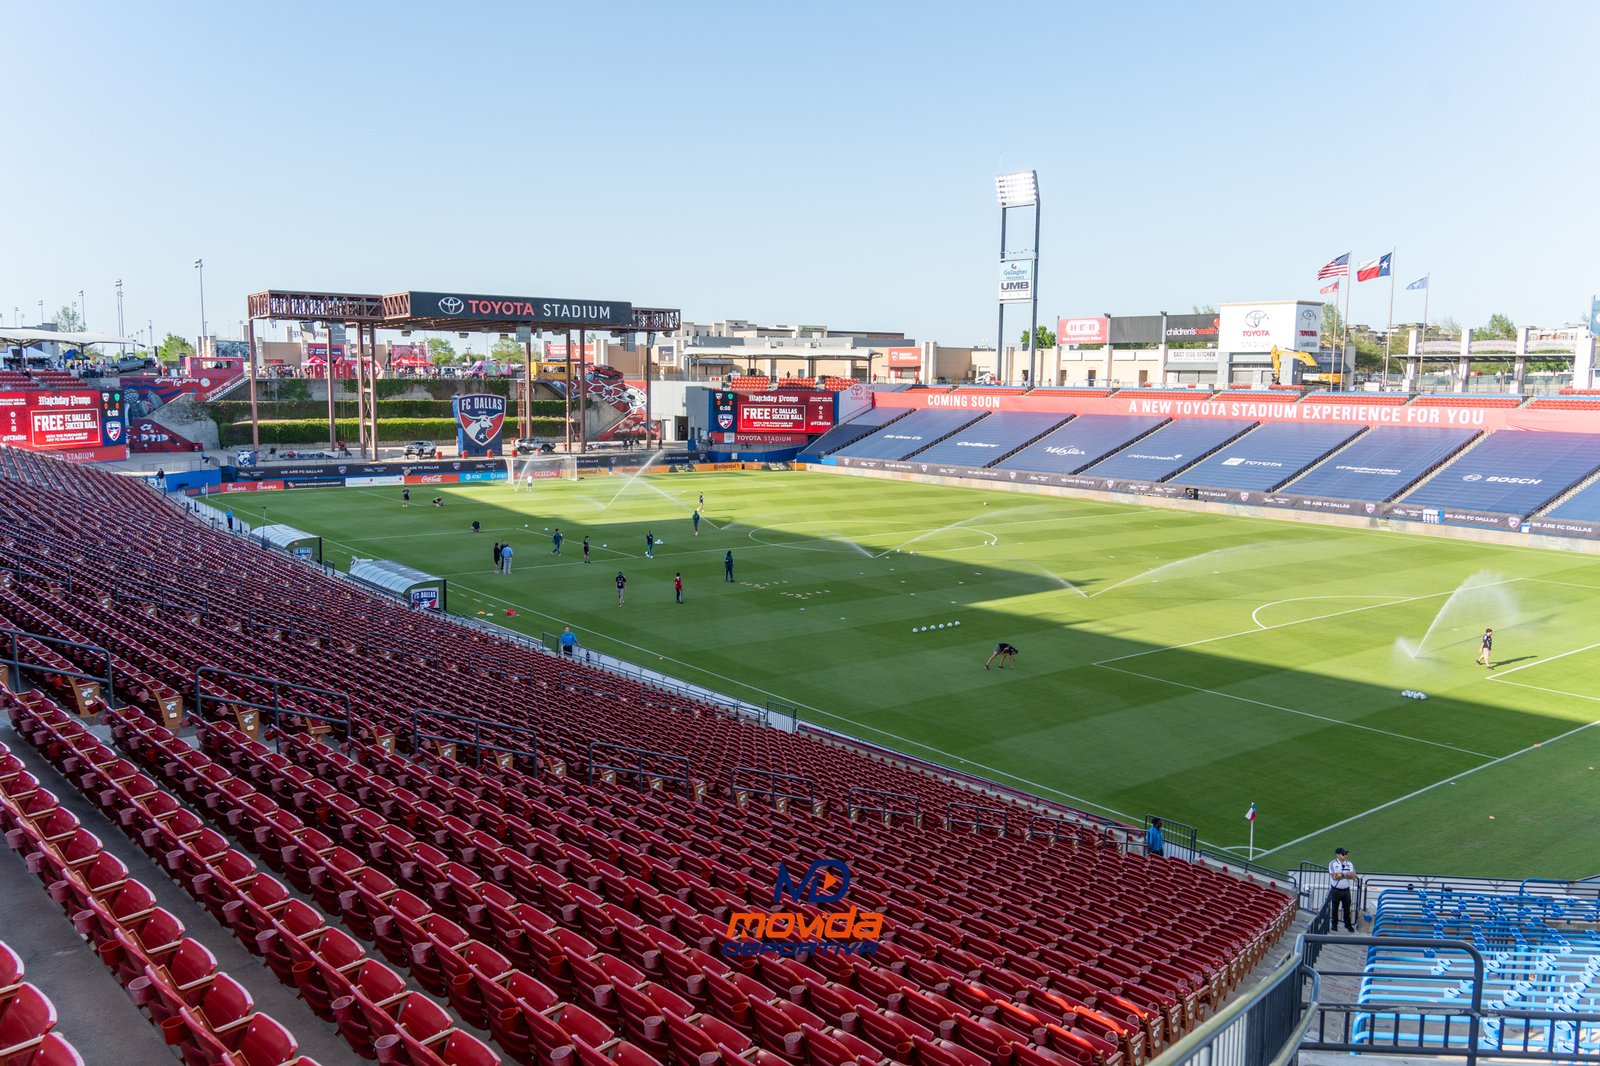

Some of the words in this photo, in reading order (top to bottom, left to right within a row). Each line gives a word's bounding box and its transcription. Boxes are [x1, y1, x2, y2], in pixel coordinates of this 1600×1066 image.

[1001, 282, 1029, 290] UMB
[468, 300, 534, 316] TOYOTA
[543, 303, 610, 319] STADIUM
[38, 396, 69, 406] Matchday
[70, 396, 91, 406] Promo
[462, 398, 471, 410] FC
[474, 397, 502, 410] DALLAS
[928, 395, 967, 407] COMING
[971, 396, 1000, 408] SOON
[743, 408, 771, 419] FREE
[1129, 401, 1137, 412] A
[1142, 401, 1172, 414] NEW
[1176, 402, 1226, 416] TOYOTA
[1232, 403, 1297, 418] STADIUM
[1303, 404, 1400, 422] EXPERIENCE
[1407, 407, 1439, 424] FOR
[1447, 408, 1484, 425] YOU
[34, 415, 64, 432] FREE
[1486, 476, 1542, 485] BOSCH
